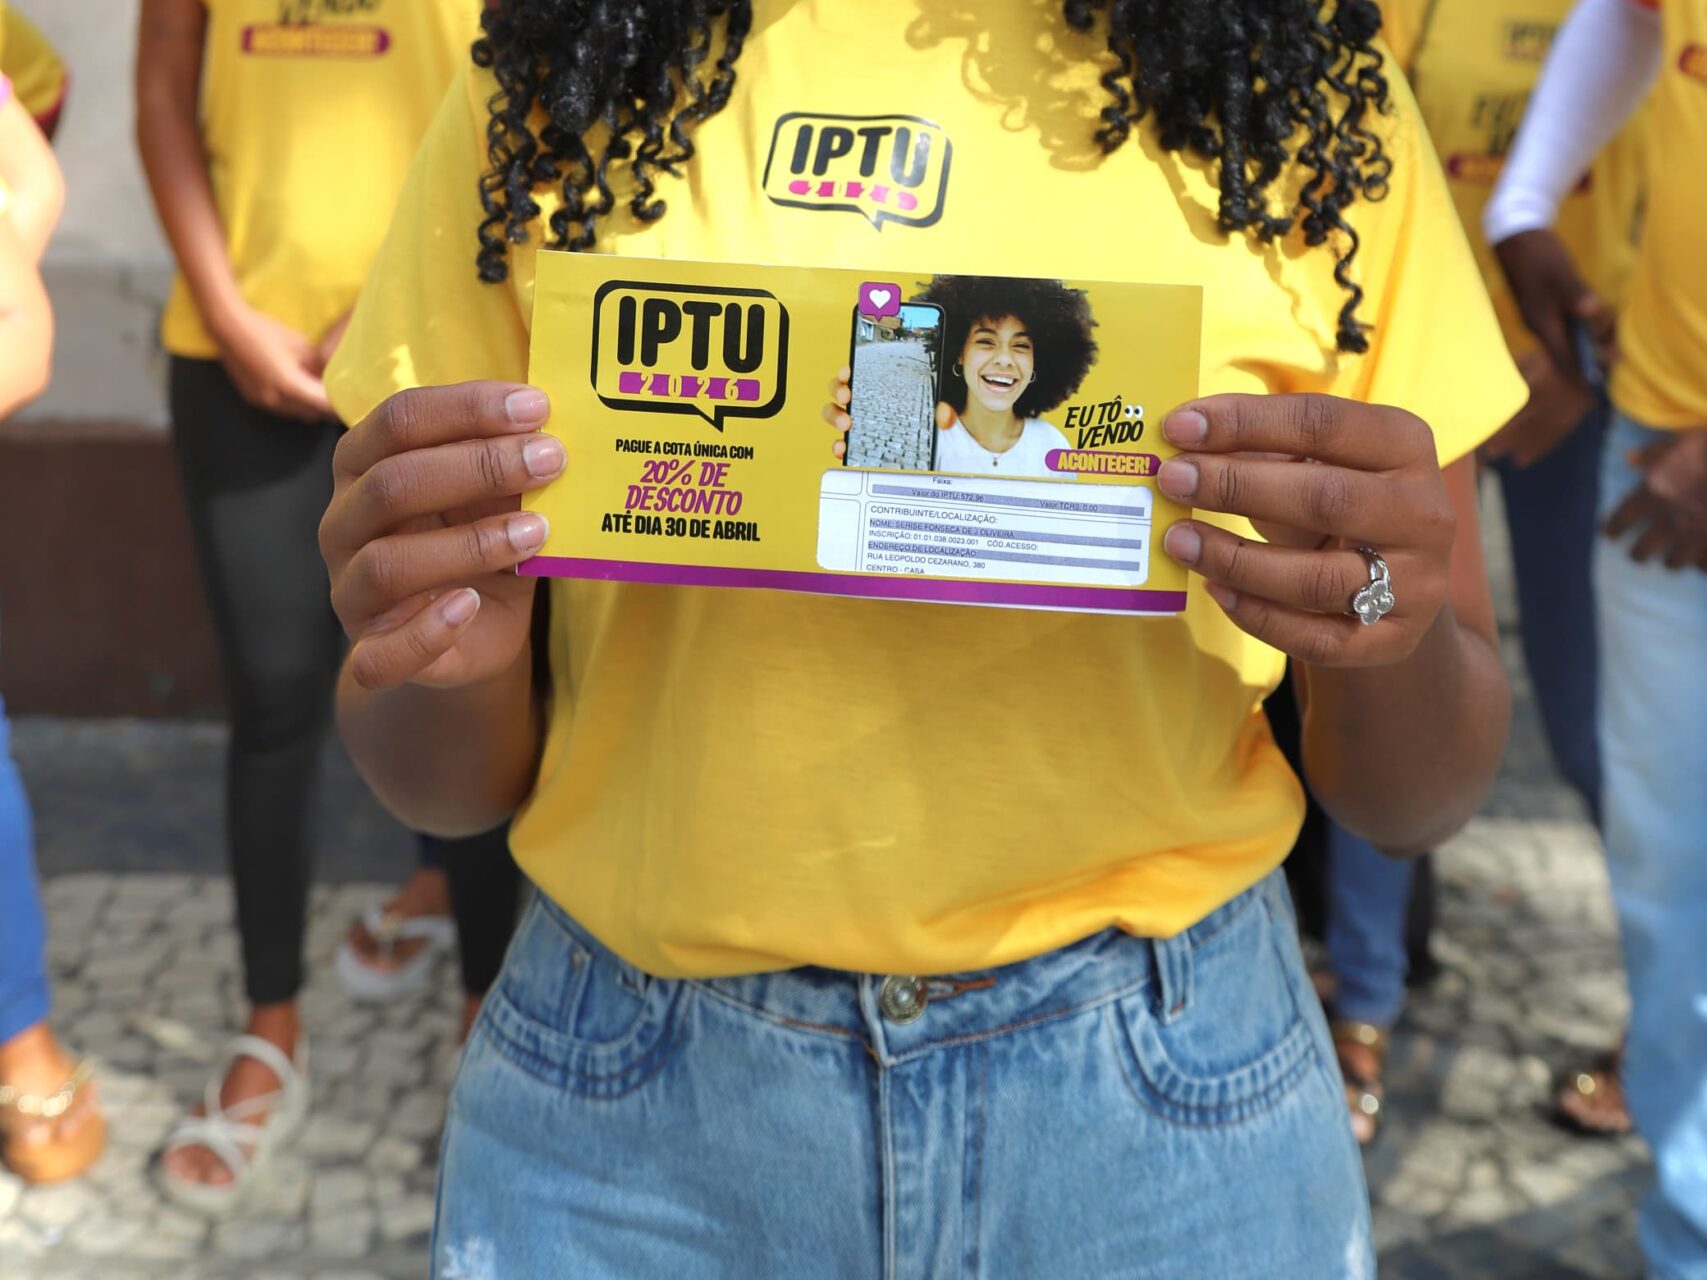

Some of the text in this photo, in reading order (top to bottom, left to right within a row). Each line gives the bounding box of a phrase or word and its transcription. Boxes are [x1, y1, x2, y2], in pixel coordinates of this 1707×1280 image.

[790, 124, 931, 188] IPTU
[617, 295, 765, 373] IPTU
[638, 372, 740, 401] 2026
[1064, 394, 1122, 428] EU TÔ
[615, 438, 754, 460] PAGUE A COTA ÚNICA COM
[1077, 420, 1144, 449] VENDO
[640, 458, 731, 487] 20% DE
[1057, 451, 1151, 475] ACONTECER!
[625, 484, 743, 516] DESCONTO
[870, 505, 998, 524] CONTRIBUINTE/LOCALIZAÇÃO:
[601, 509, 761, 542] ATÉ DIA 30 DE ABRIL
[924, 523, 960, 533] FONSECA
[962, 525, 973, 534] DE
[867, 552, 883, 561] RUA
[885, 554, 926, 564] LEOPOLDO
[868, 541, 911, 552] ENDEREÇO
[912, 543, 923, 553] DE
[866, 564, 898, 573] CENTRO
